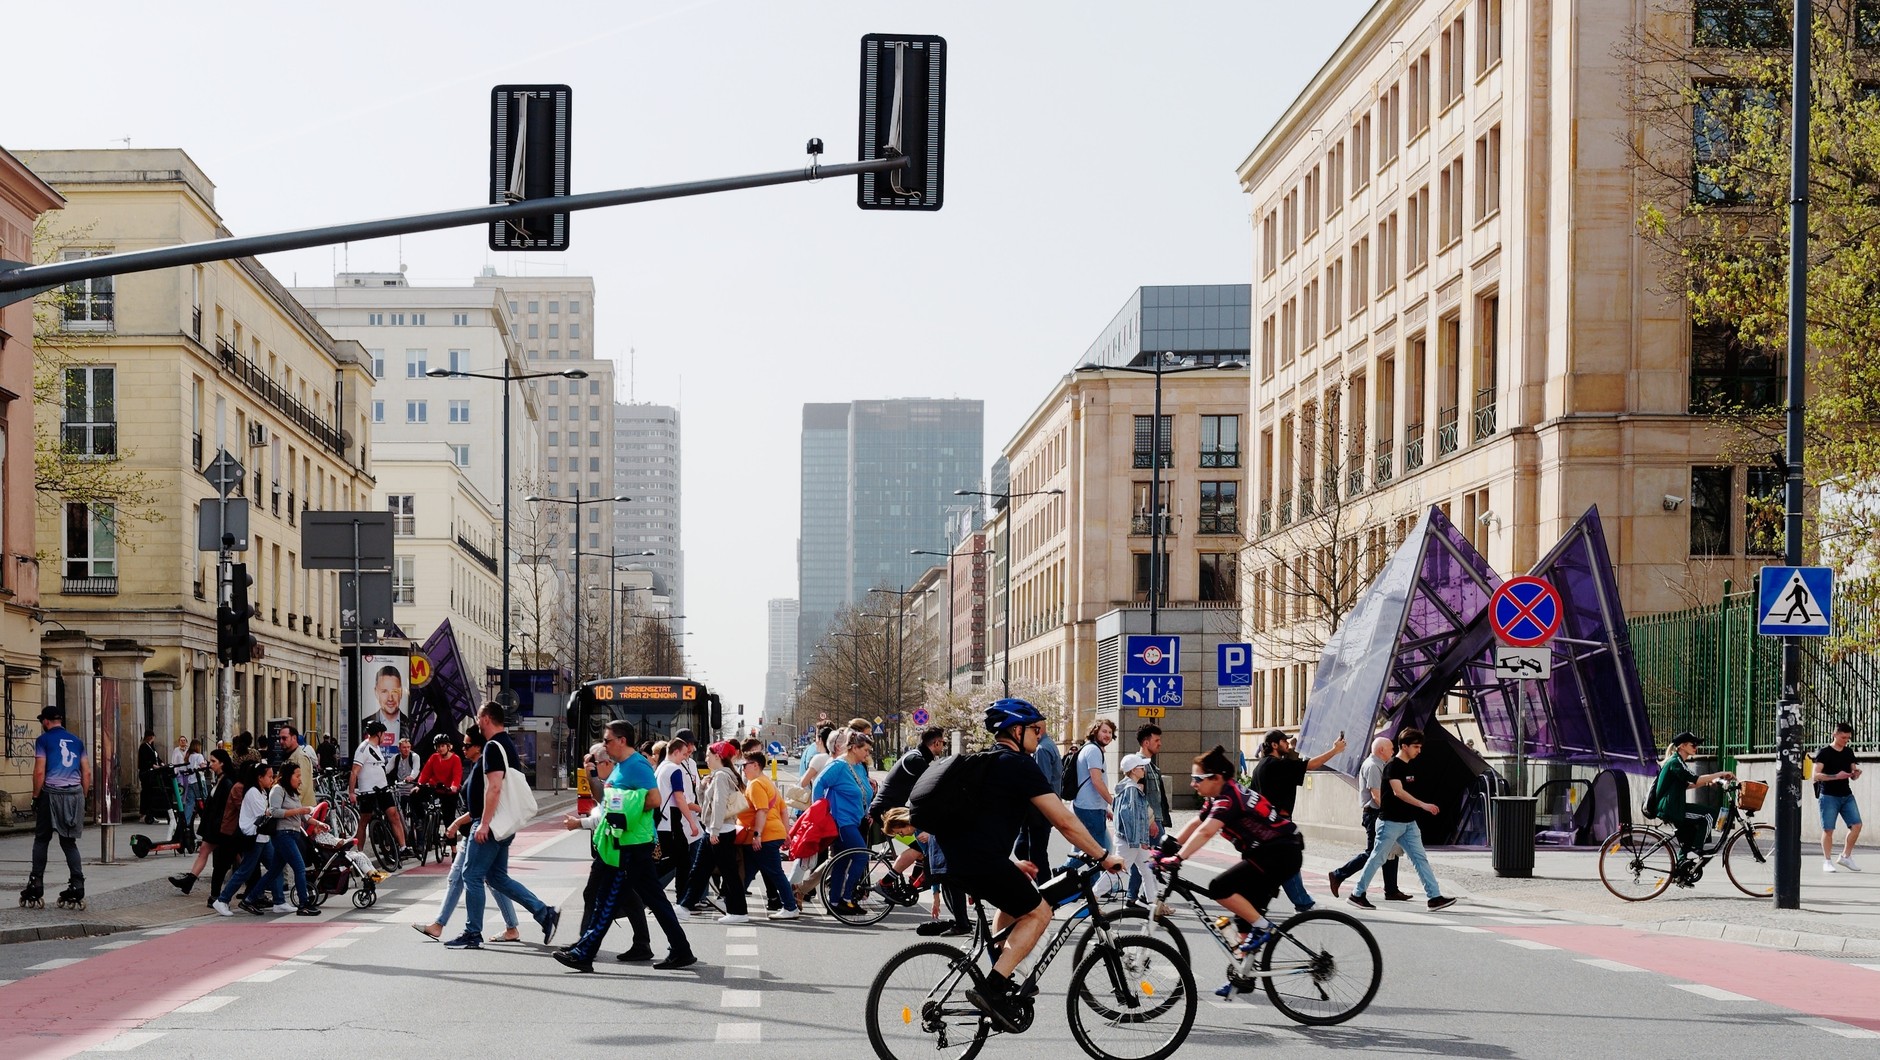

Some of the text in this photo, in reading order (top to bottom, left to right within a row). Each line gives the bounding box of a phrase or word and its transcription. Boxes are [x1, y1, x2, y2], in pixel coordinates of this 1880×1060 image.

[1225, 647, 1245, 674] P
[594, 685, 614, 700] 106
[1145, 707, 1160, 717] 719
